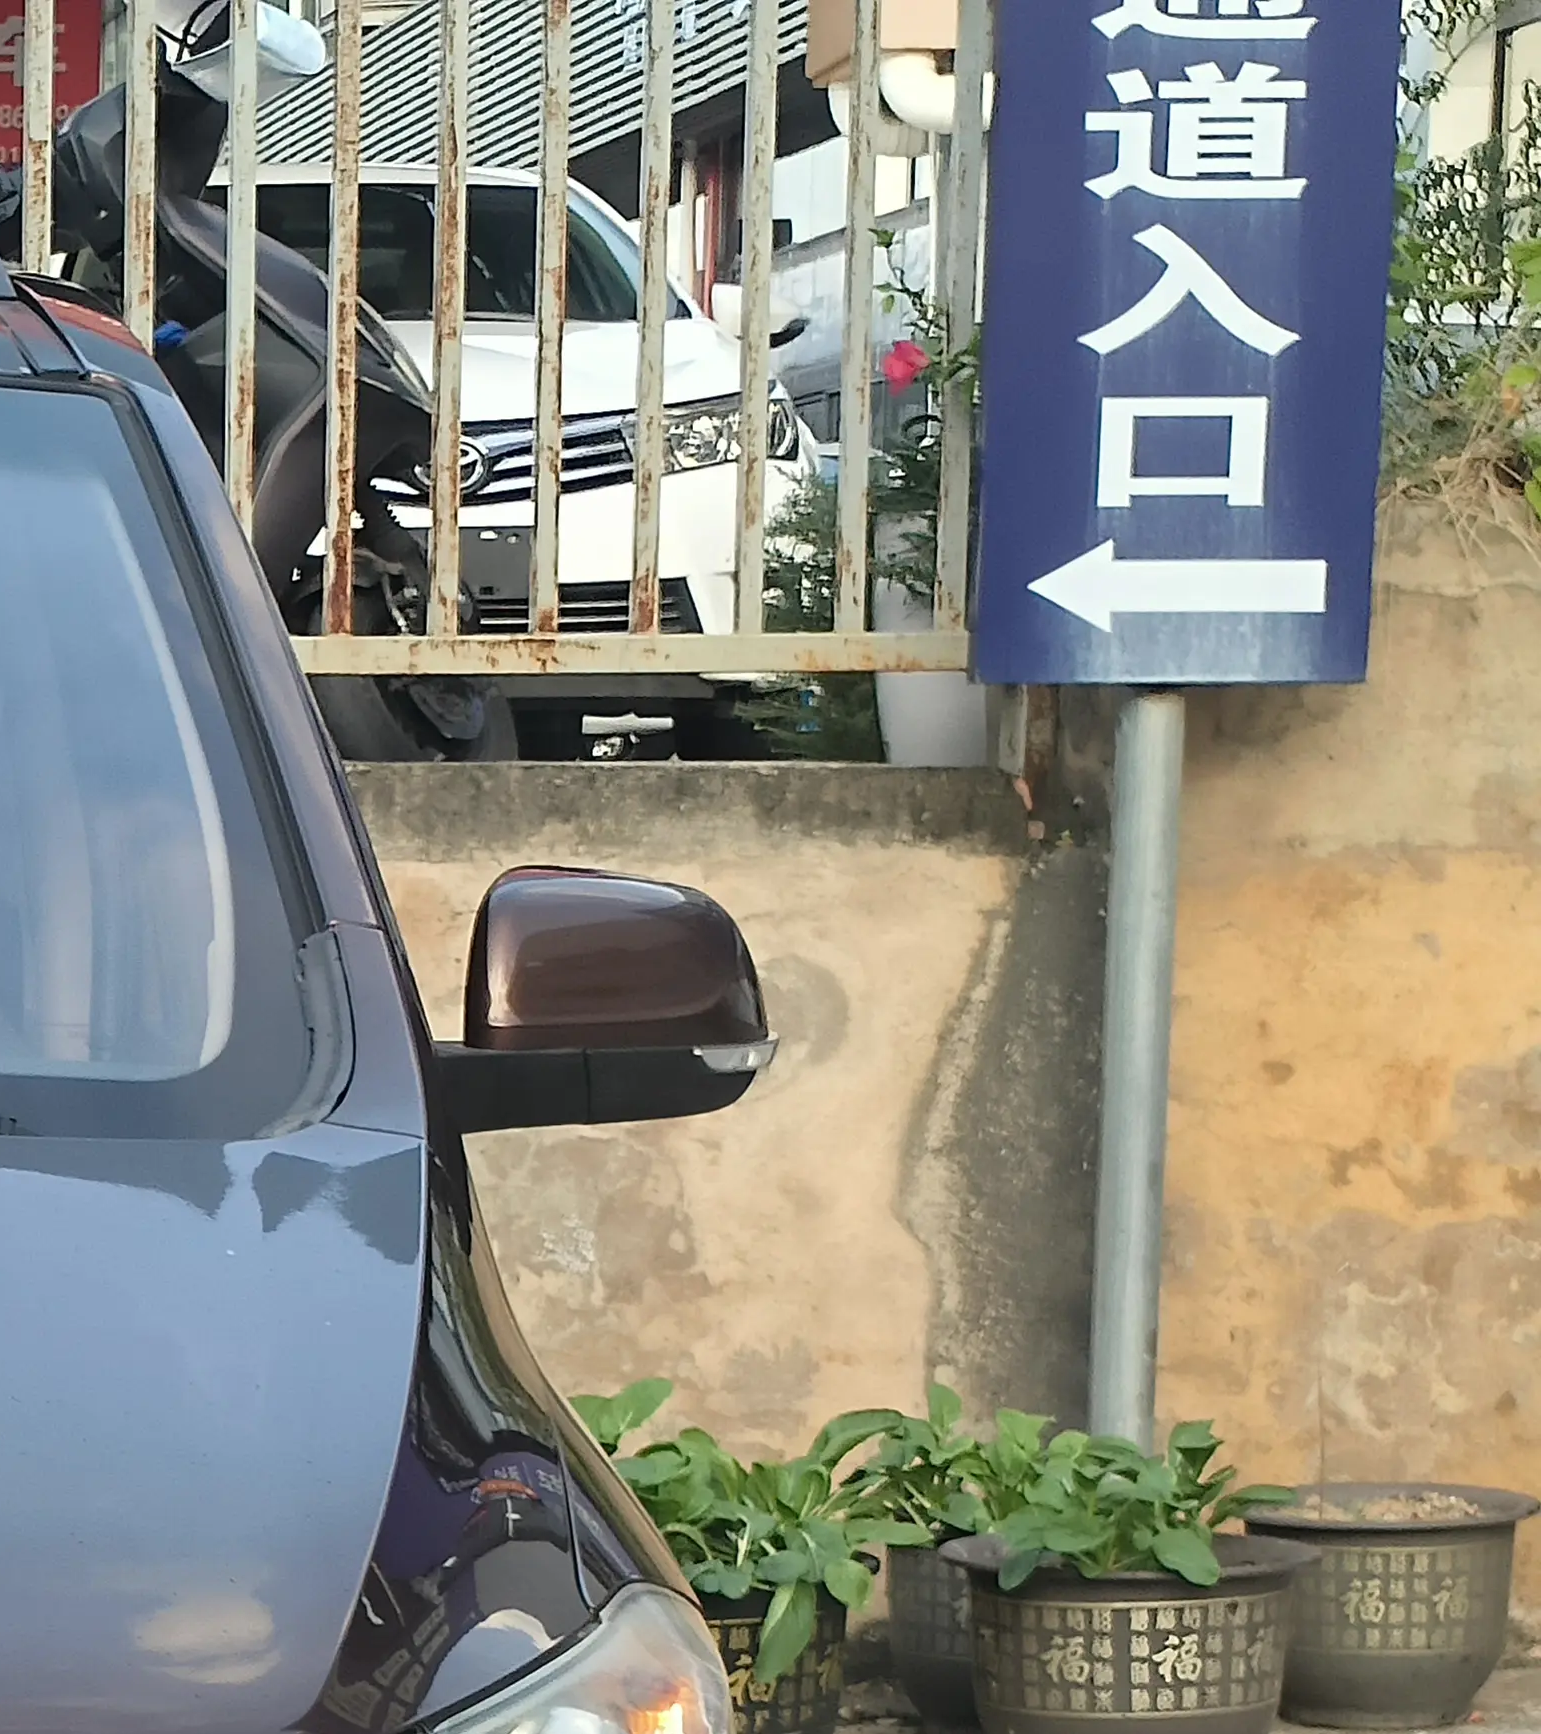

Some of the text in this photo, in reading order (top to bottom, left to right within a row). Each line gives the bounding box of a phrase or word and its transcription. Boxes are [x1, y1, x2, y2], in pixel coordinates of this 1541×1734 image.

[1077, 0, 1319, 508] 道入口
[1339, 1577, 1385, 1625] 福
[1040, 1634, 1090, 1684] 福
[1152, 1633, 1202, 1684] 福
